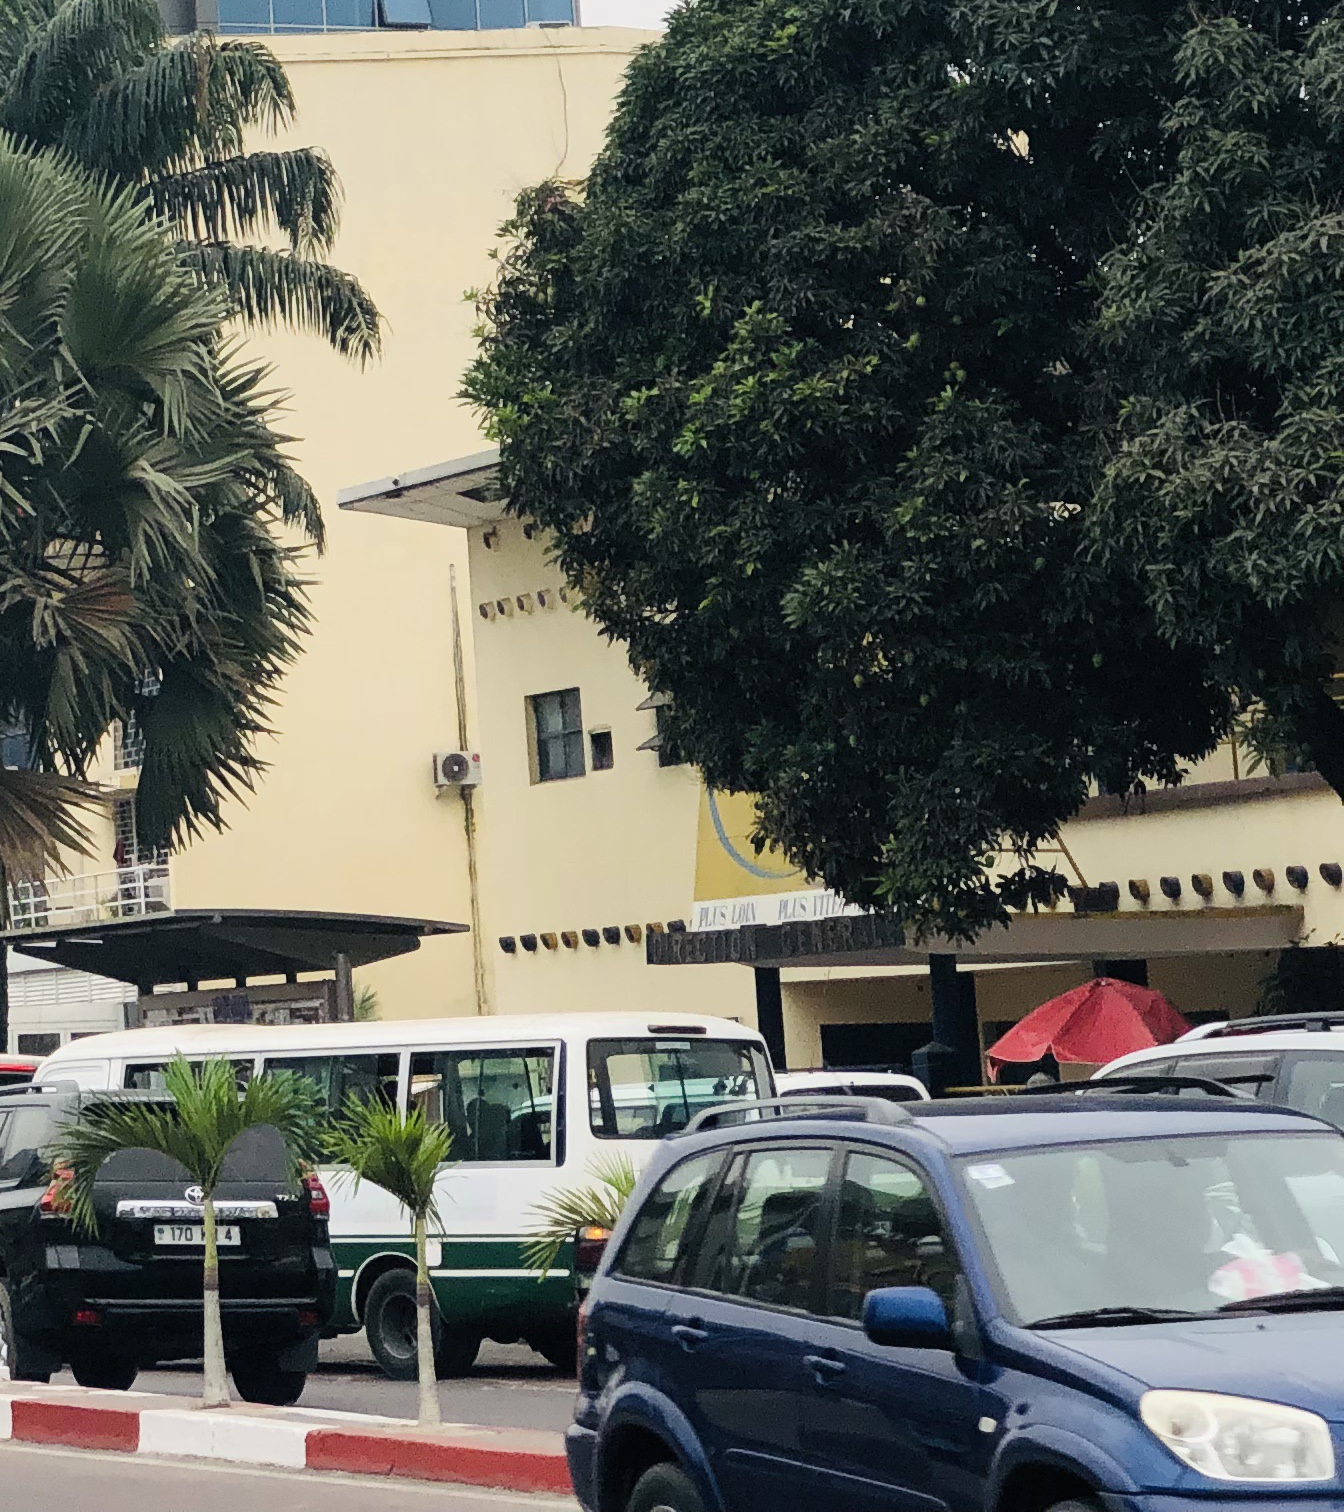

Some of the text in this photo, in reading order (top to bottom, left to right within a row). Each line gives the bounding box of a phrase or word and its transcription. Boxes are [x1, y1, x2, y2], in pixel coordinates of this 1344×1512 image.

[699, 904, 729, 928] PLUS
[731, 901, 757, 925] LOIN
[778, 897, 807, 922] PLUS
[170, 1227, 193, 1242] 170
[224, 1227, 233, 1243] 4
